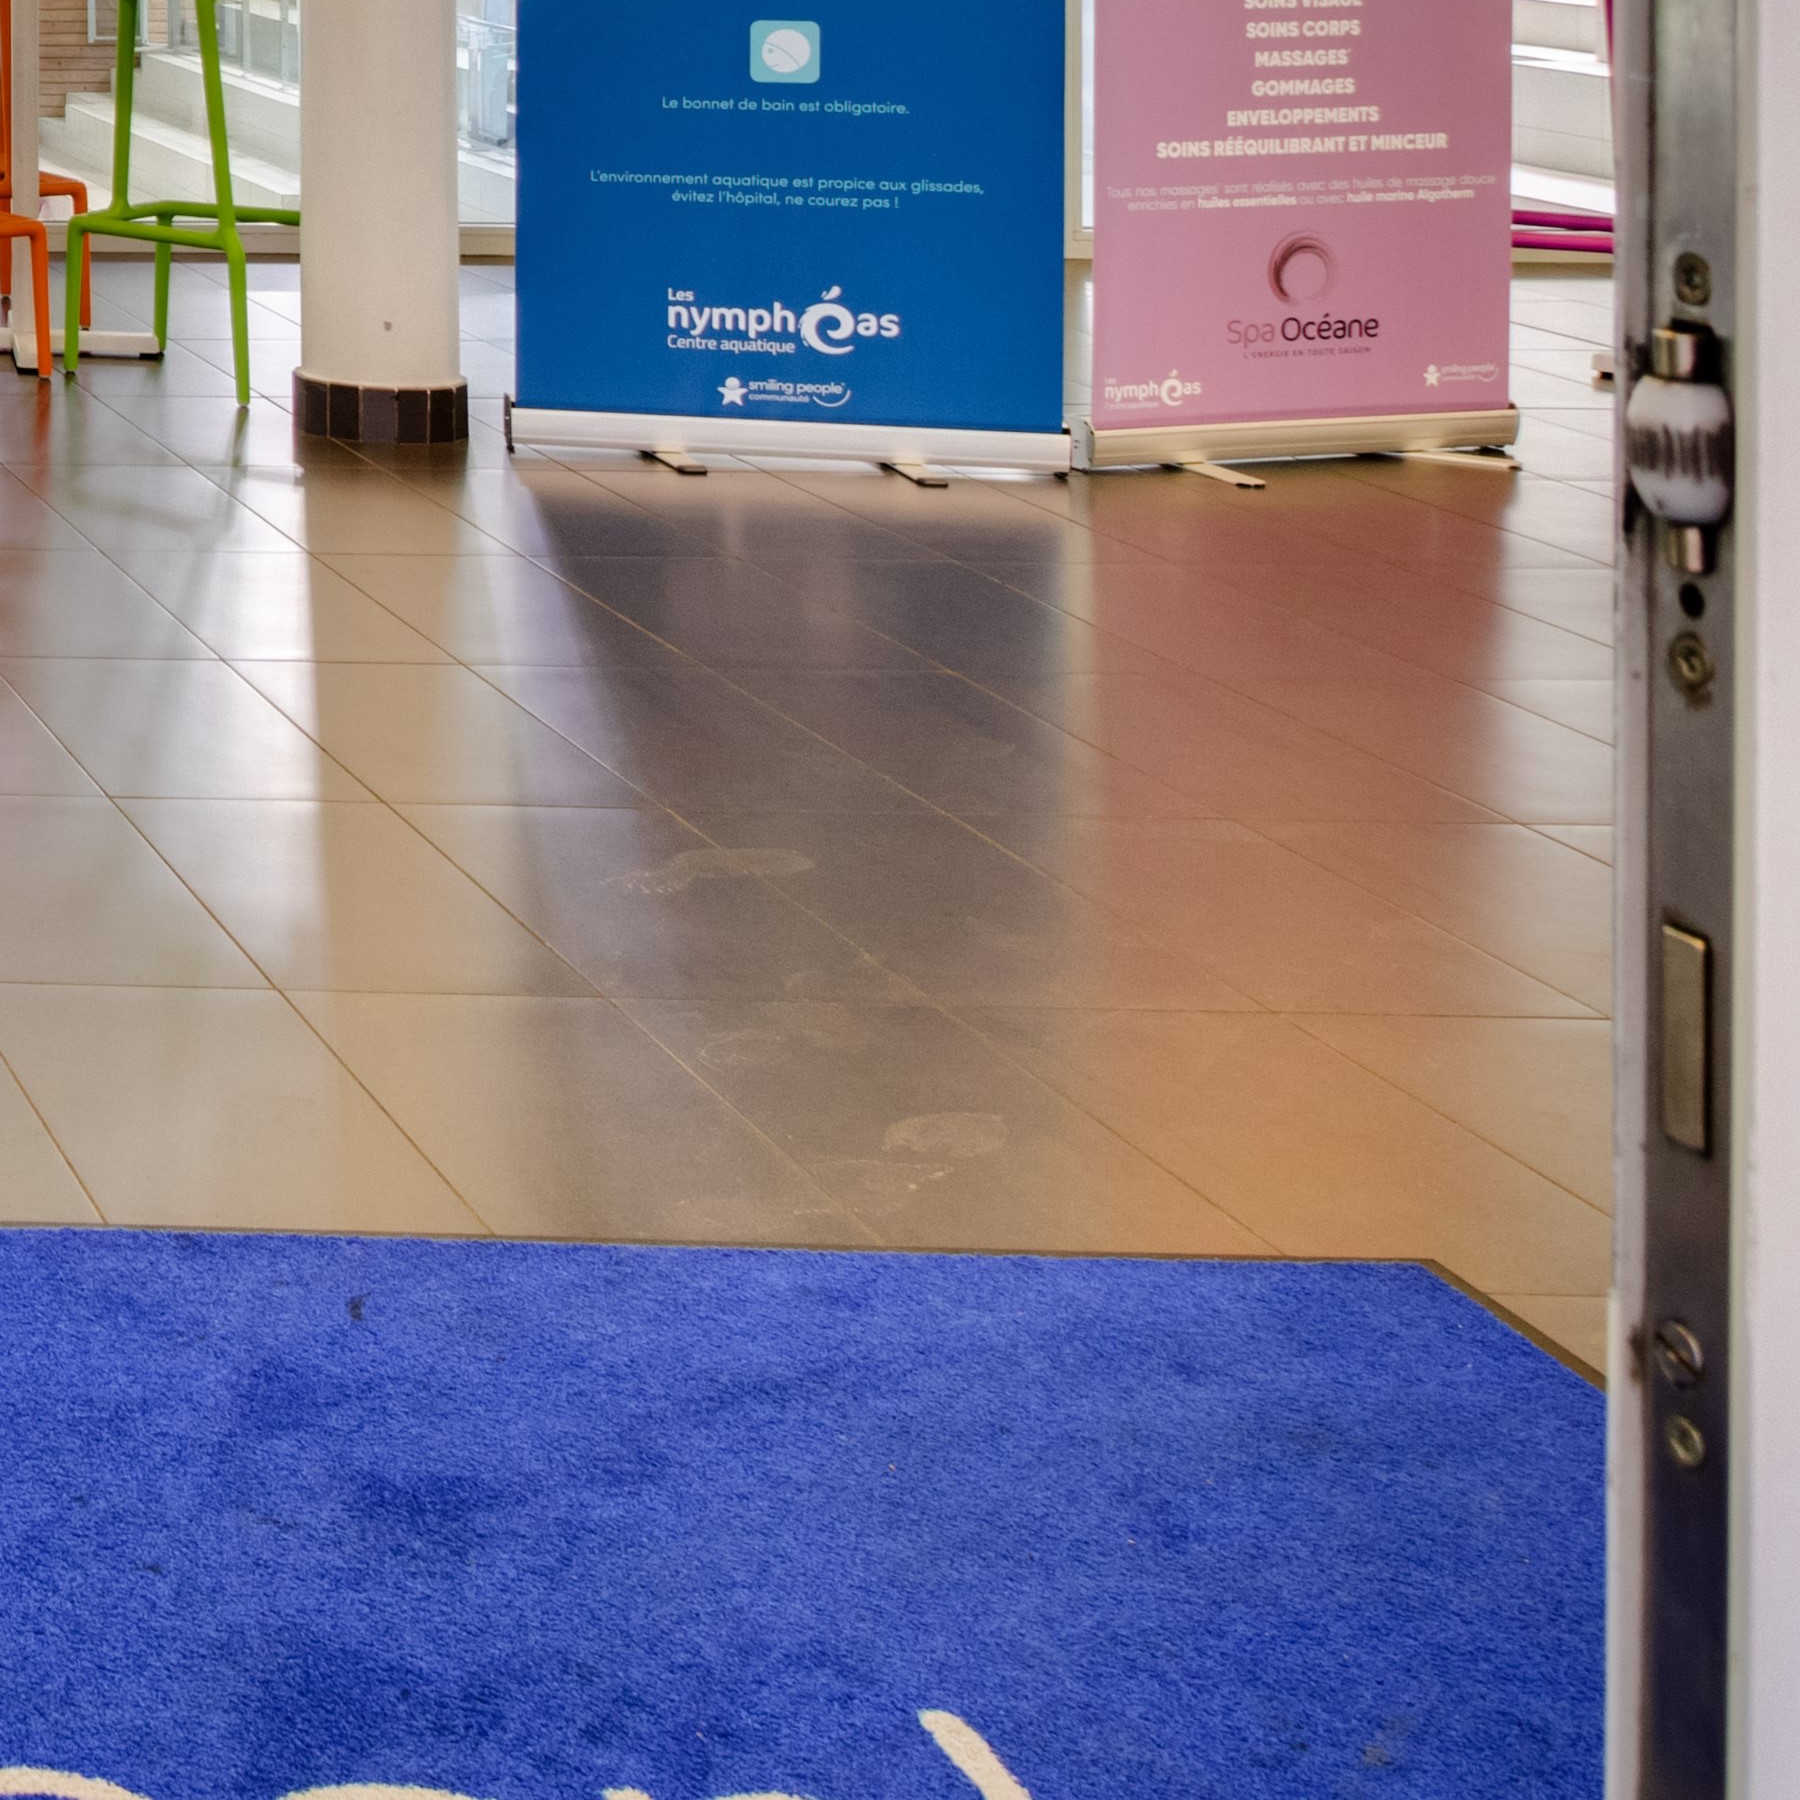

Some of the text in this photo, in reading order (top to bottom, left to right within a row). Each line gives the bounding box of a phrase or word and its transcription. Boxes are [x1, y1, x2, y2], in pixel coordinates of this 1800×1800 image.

[1246, 20, 1361, 38] SOINS CORPS
[1251, 77, 1355, 97] GOMMAGES
[662, 96, 909, 116] Le bonnet de bain est obligatoire.
[1227, 106, 1379, 127] ENVELOPPEMENTS
[1156, 141, 1210, 159] SOINS
[1349, 135, 1368, 152] ET
[1371, 133, 1447, 150] MINCEUR
[591, 170, 983, 194] L'environnement aquatique est propice aux glissades,
[672, 189, 889, 209] évitez l'hôpital, ne courez pas
[668, 288, 694, 301] Les
[667, 286, 899, 355] nymphéas
[1227, 312, 1379, 349] Spa Océane
[667, 335, 795, 355] Centre aquatique
[749, 379, 842, 397] smiling people
